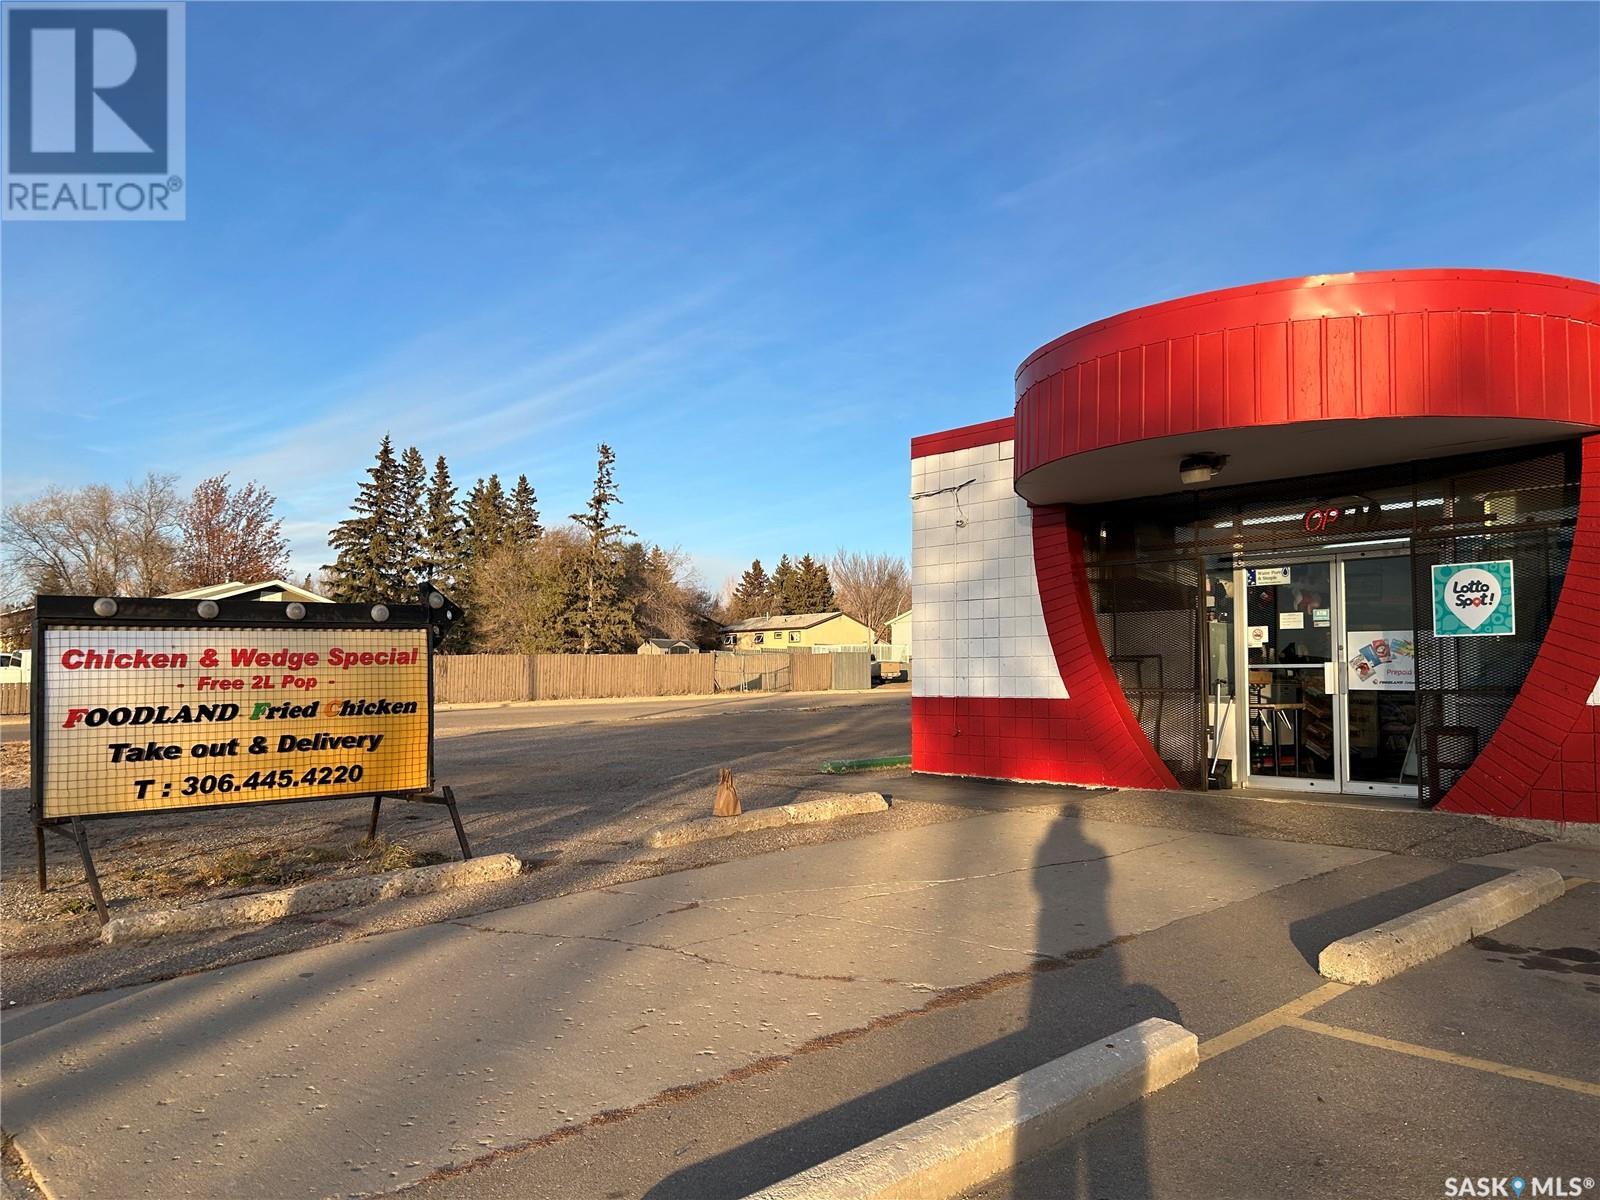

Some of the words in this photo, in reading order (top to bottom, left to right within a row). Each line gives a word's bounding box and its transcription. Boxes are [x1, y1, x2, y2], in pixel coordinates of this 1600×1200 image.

[1453, 580, 1490, 594] Lotto
[1455, 593, 1495, 609] Spot!
[61, 648, 188, 670] Chicken
[198, 648, 220, 669] &
[231, 648, 320, 671] Wedge
[327, 647, 418, 670] Special
[197, 676, 245, 691] Free
[251, 675, 275, 690] 2L
[281, 674, 318, 691] Pop
[62, 703, 240, 729] FOODLAND
[249, 701, 320, 721] Fried
[324, 698, 418, 718] Chicken
[108, 742, 183, 763] Take
[191, 738, 240, 758] out
[248, 735, 269, 755] &
[277, 732, 384, 753] Delivery
[134, 779, 155, 800] T
[181, 764, 363, 797] 306.445.4220
